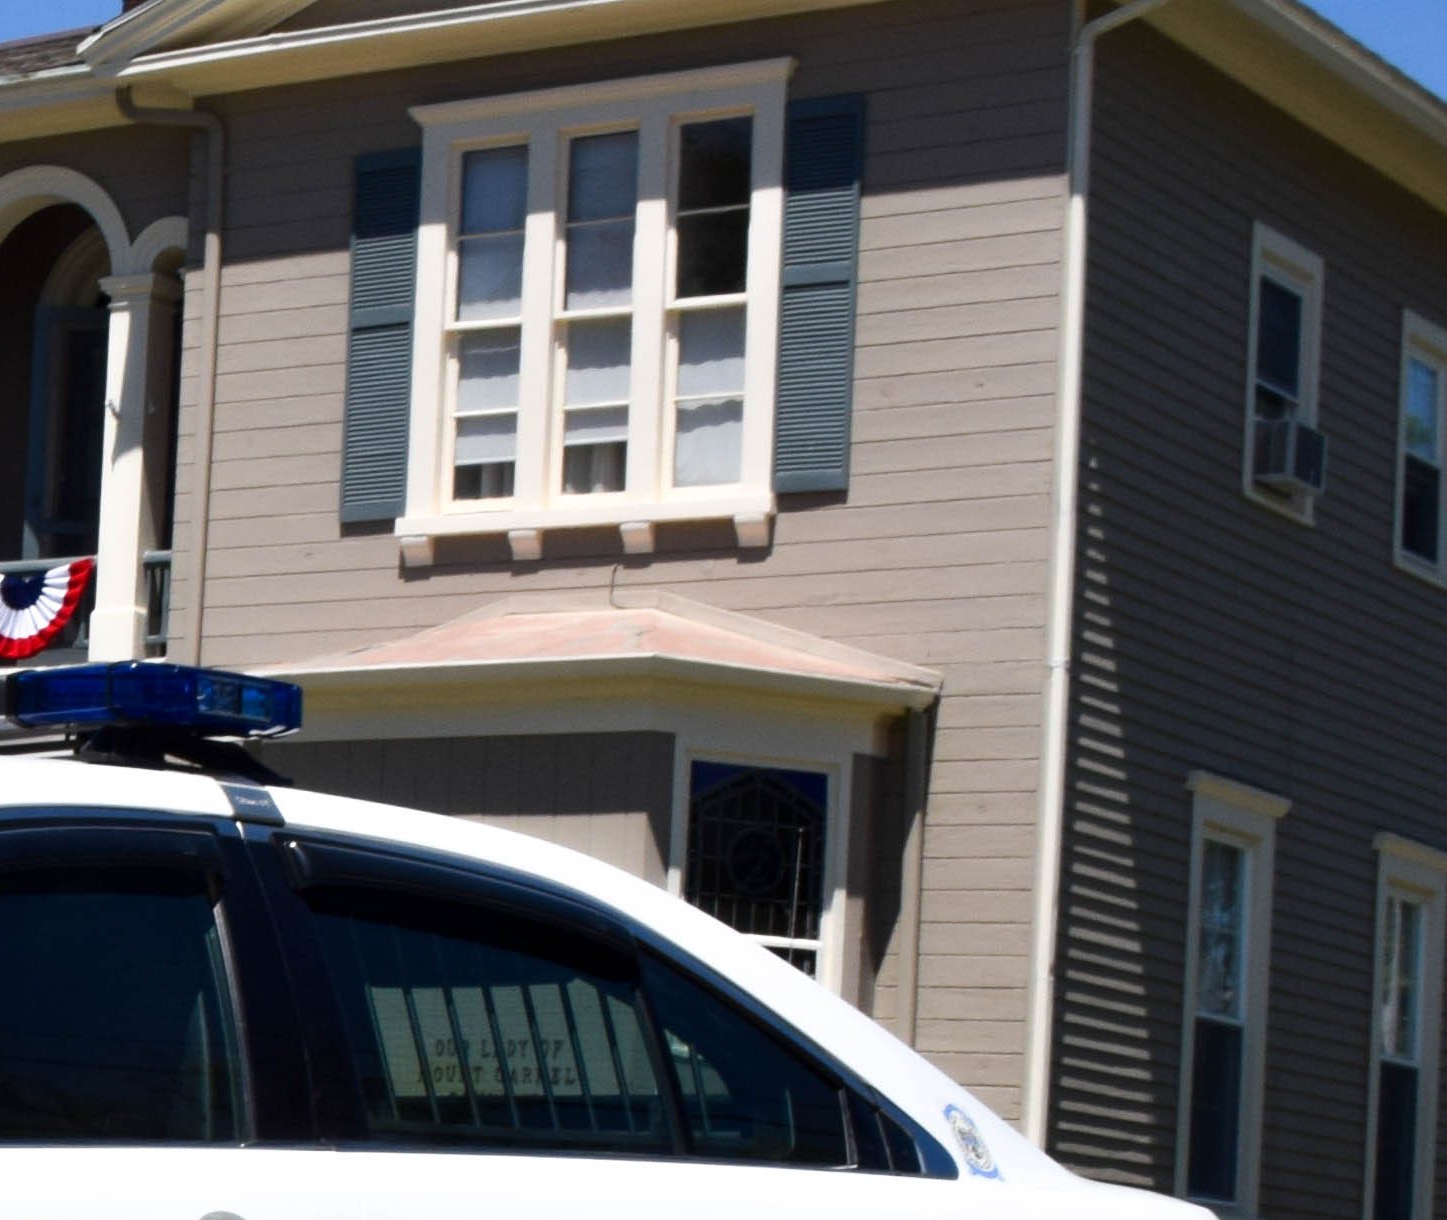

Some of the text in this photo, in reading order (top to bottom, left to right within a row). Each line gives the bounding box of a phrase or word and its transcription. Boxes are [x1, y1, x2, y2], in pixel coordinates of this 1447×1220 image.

[480, 1039, 530, 1058] LDY
[417, 1065, 576, 1086] OUT CAREL
